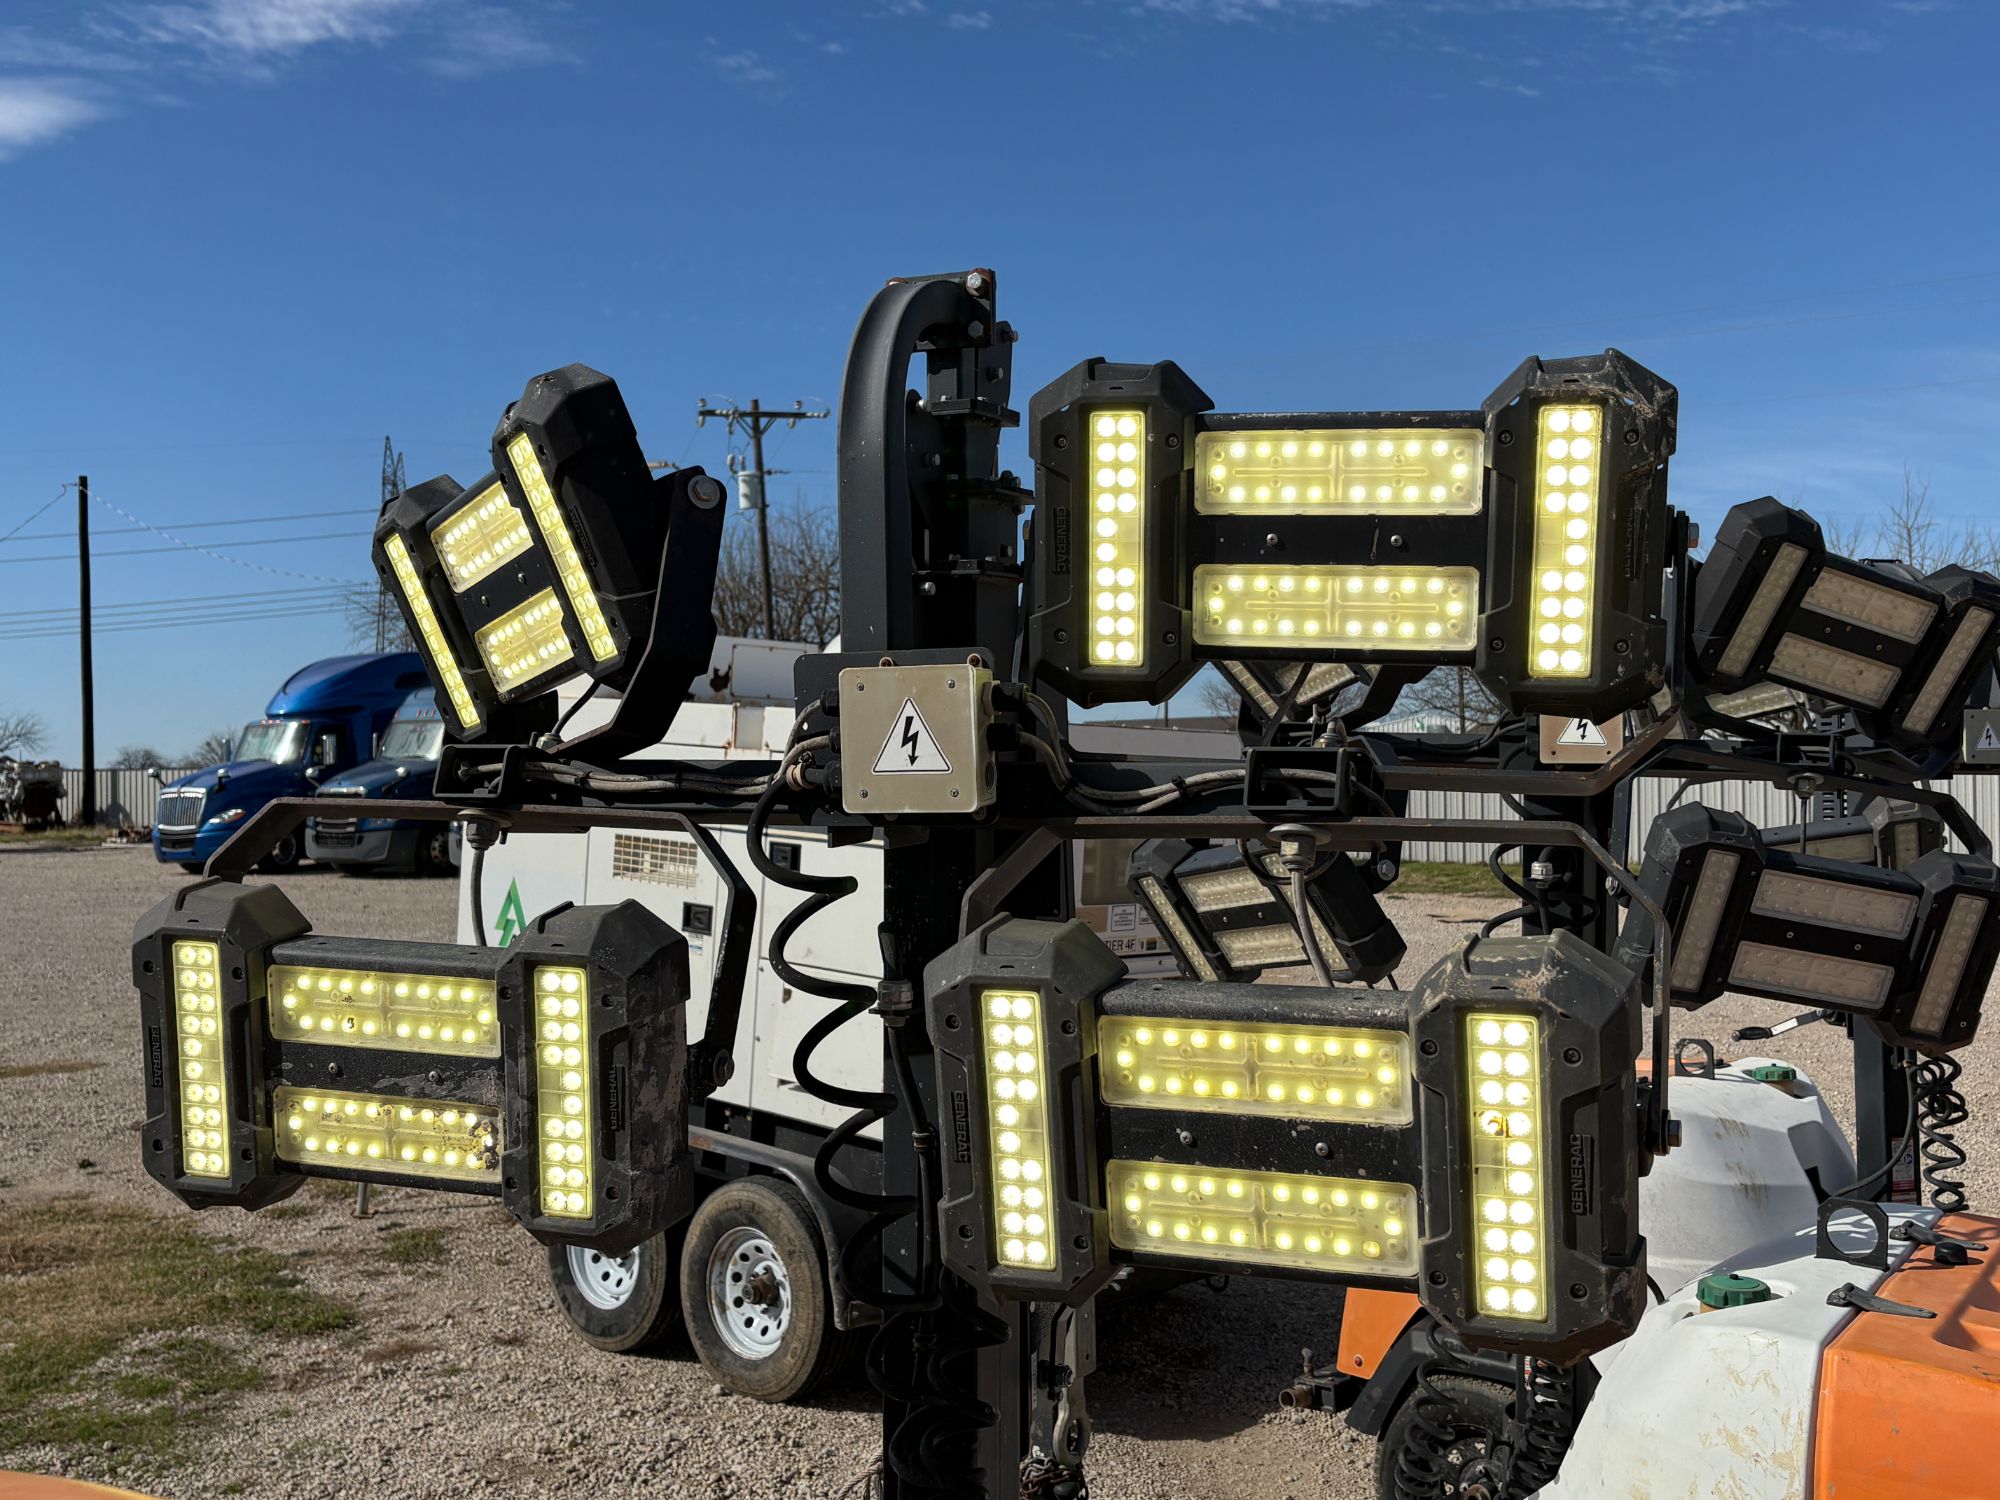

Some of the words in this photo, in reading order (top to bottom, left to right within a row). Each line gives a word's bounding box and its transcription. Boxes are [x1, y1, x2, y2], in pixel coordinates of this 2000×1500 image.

[1056, 506, 1067, 572] GENERAC
[151, 1025, 163, 1087] GENERAC
[953, 1090, 969, 1162] GENERAC
[1569, 1134, 1584, 1214] GENERAC
